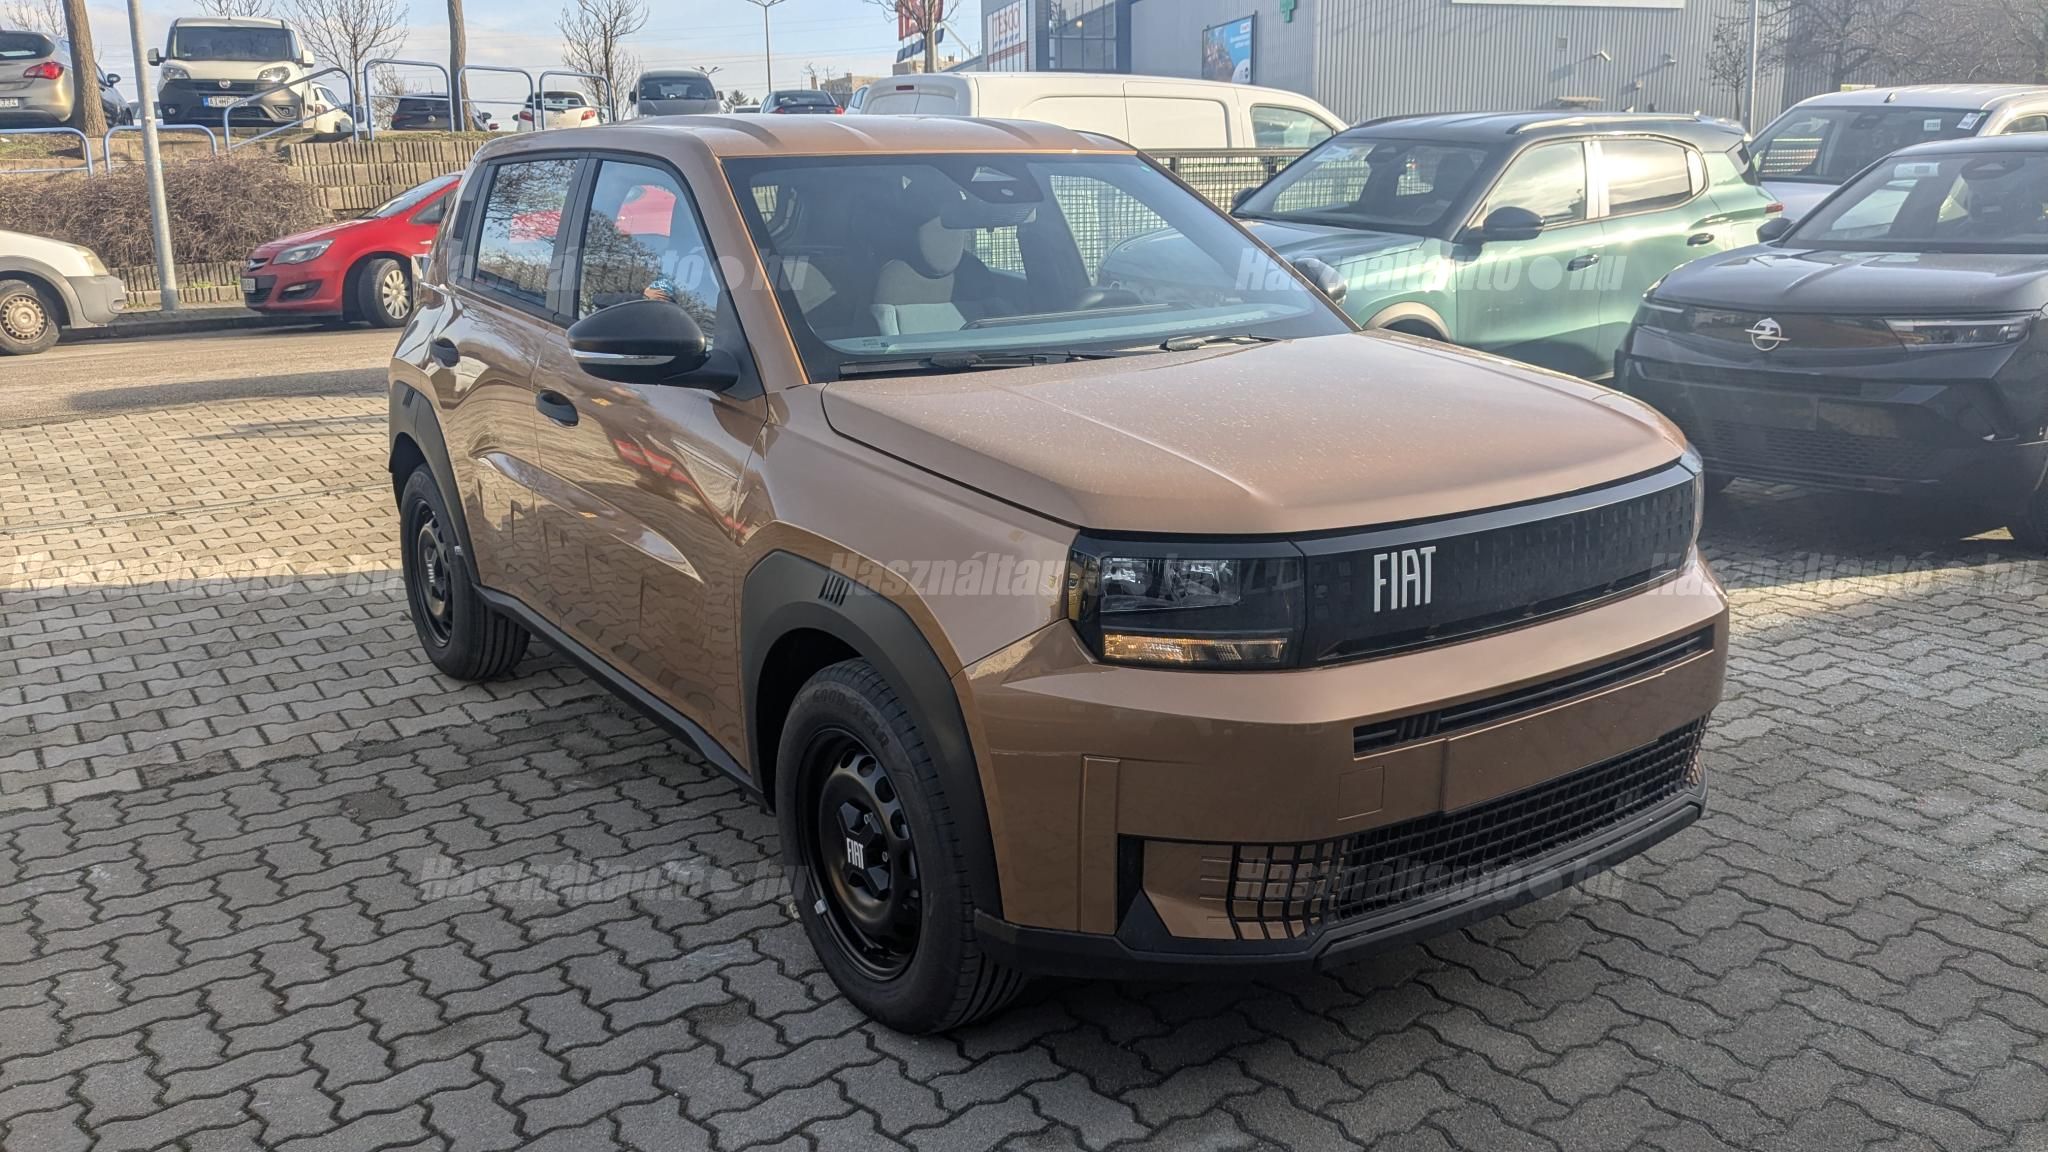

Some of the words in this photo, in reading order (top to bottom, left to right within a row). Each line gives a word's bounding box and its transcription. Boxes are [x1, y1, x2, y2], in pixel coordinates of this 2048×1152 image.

[993, 8, 1020, 35] TESCO
[1373, 546, 1437, 613] FIAT
[846, 837, 864, 870] FIAT
